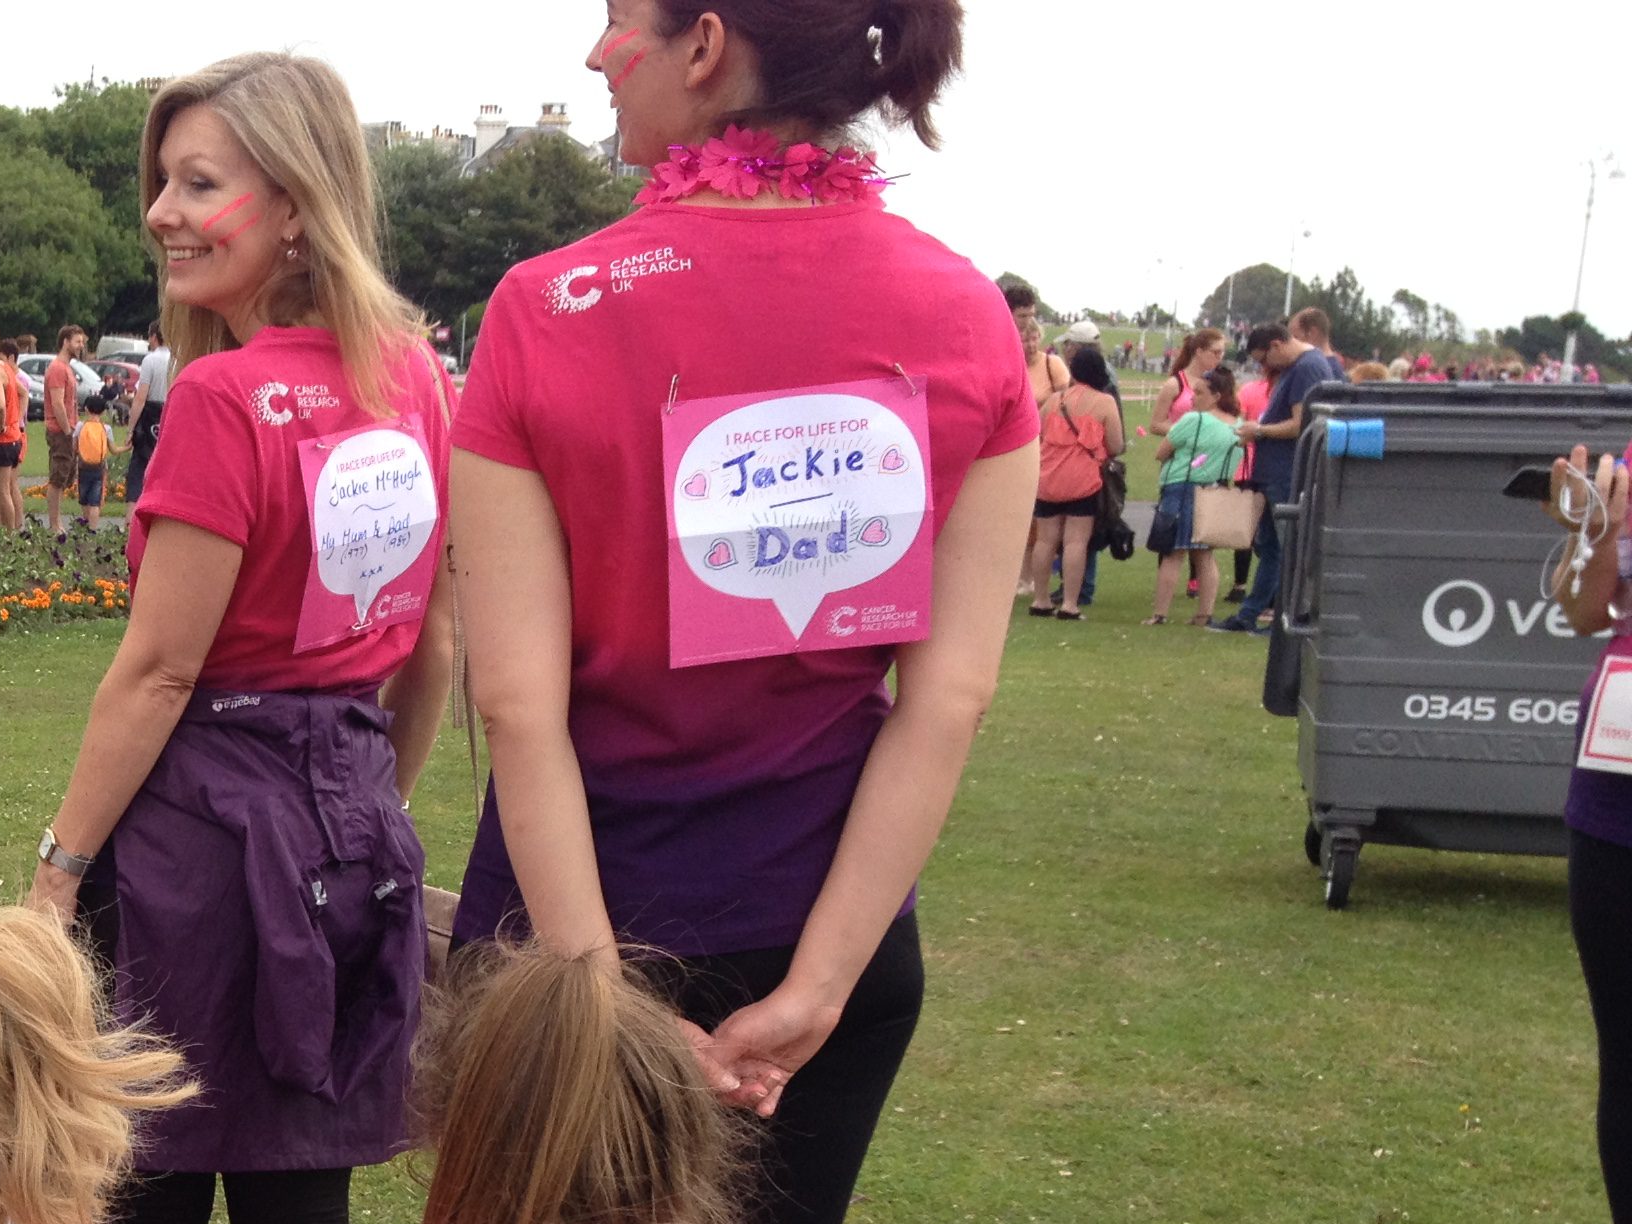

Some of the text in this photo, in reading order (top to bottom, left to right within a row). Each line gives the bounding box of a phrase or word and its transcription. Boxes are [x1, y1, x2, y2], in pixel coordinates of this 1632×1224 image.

[609, 247, 674, 270] CANCER
[610, 258, 692, 280] RESEARCH
[612, 279, 634, 294] UK
[294, 385, 329, 396] CANCER
[297, 396, 340, 408] RESEARCH
[298, 408, 312, 419] UK
[726, 419, 869, 446] I RACE FOR LIFE FOR
[340, 459, 360, 473] RACE
[361, 455, 376, 467] FOR
[376, 451, 391, 464] LIFE
[391, 448, 406, 459] FOR
[329, 459, 422, 507] Jackie McHugh
[321, 532, 335, 560] My
[342, 528, 367, 546] Mum
[387, 512, 410, 535] Dad
[754, 510, 848, 568] Dad
[861, 604, 896, 615] CANCER
[861, 610, 918, 623] RESEARCH UK
[861, 623, 881, 632] RACE
[883, 620, 900, 630] FOR
[1404, 694, 1580, 725] 0345 606
